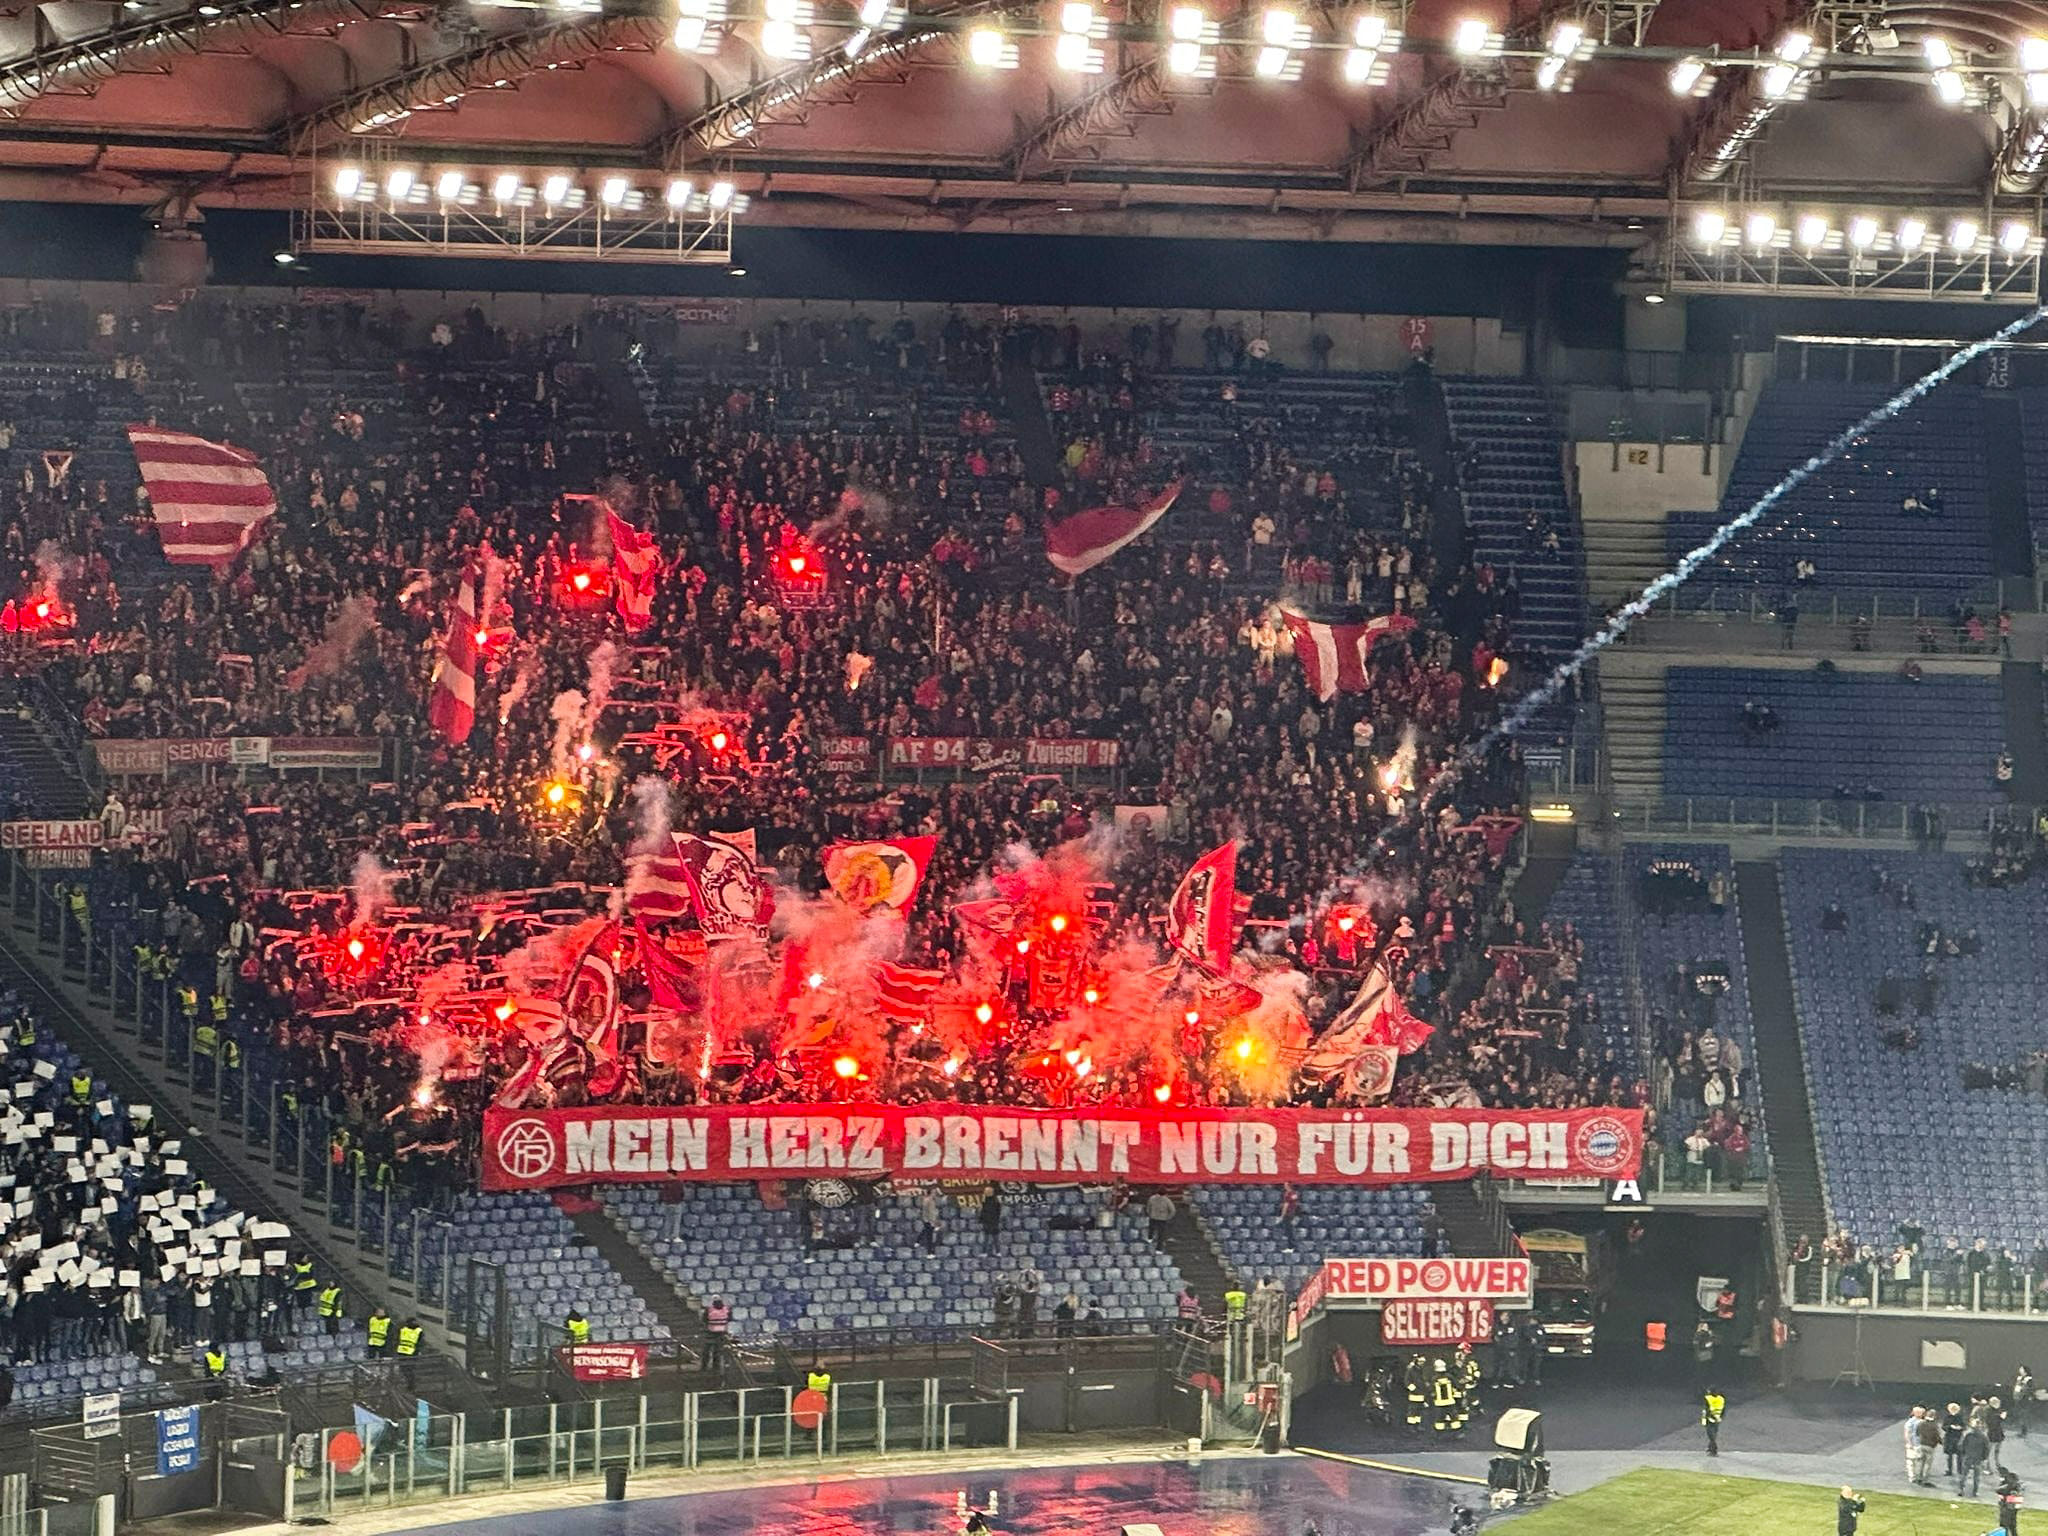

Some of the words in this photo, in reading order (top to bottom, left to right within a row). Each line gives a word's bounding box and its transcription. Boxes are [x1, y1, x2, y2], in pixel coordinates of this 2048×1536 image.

[1408, 318, 1426, 334] 15
[1411, 334, 1423, 350] A
[168, 741, 230, 760] SENZIG
[891, 742, 925, 764] AF
[933, 740, 966, 762] 94
[1026, 739, 1088, 765] Zwiesel
[1, 822, 102, 847] SEELAND
[564, 1117, 709, 1174] MEIN
[728, 1116, 886, 1170] HERZ
[903, 1116, 1141, 1174] BRENNT
[1159, 1121, 1278, 1175] NUR
[1297, 1111, 1412, 1175] FÜR
[1430, 1121, 1569, 1173] DICH
[1612, 1179, 1642, 1201] A
[1326, 1261, 1391, 1293] RED
[1396, 1259, 1528, 1293] POWER
[1384, 1301, 1465, 1339] SELTERS
